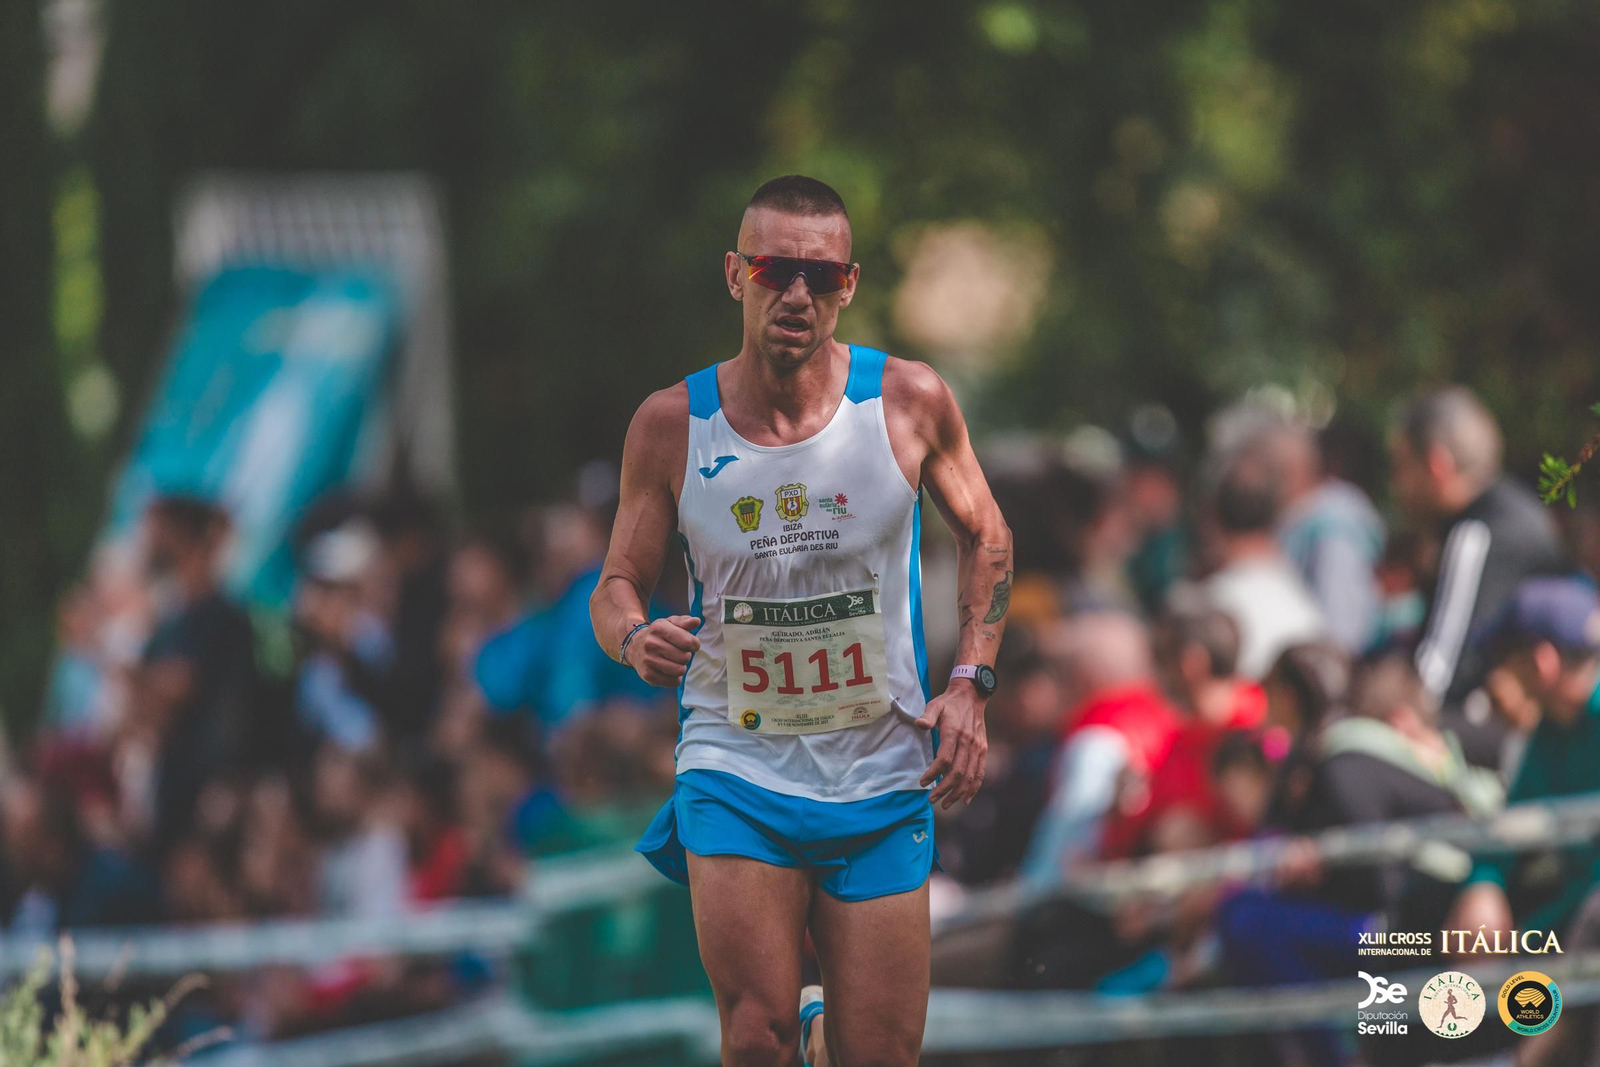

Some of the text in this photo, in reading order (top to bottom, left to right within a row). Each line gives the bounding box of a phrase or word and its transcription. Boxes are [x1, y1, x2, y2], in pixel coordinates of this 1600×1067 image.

[784, 489, 799, 498] PXD
[833, 505, 847, 515] riu
[783, 522, 803, 532] IBIZA
[750, 529, 839, 550] PEÑA DEPORTIVA
[754, 550, 778, 560] SANTA
[810, 543, 824, 551] DES
[825, 542, 838, 550] RIU
[763, 603, 837, 622] ITÁLICA
[741, 642, 873, 695] 5111
